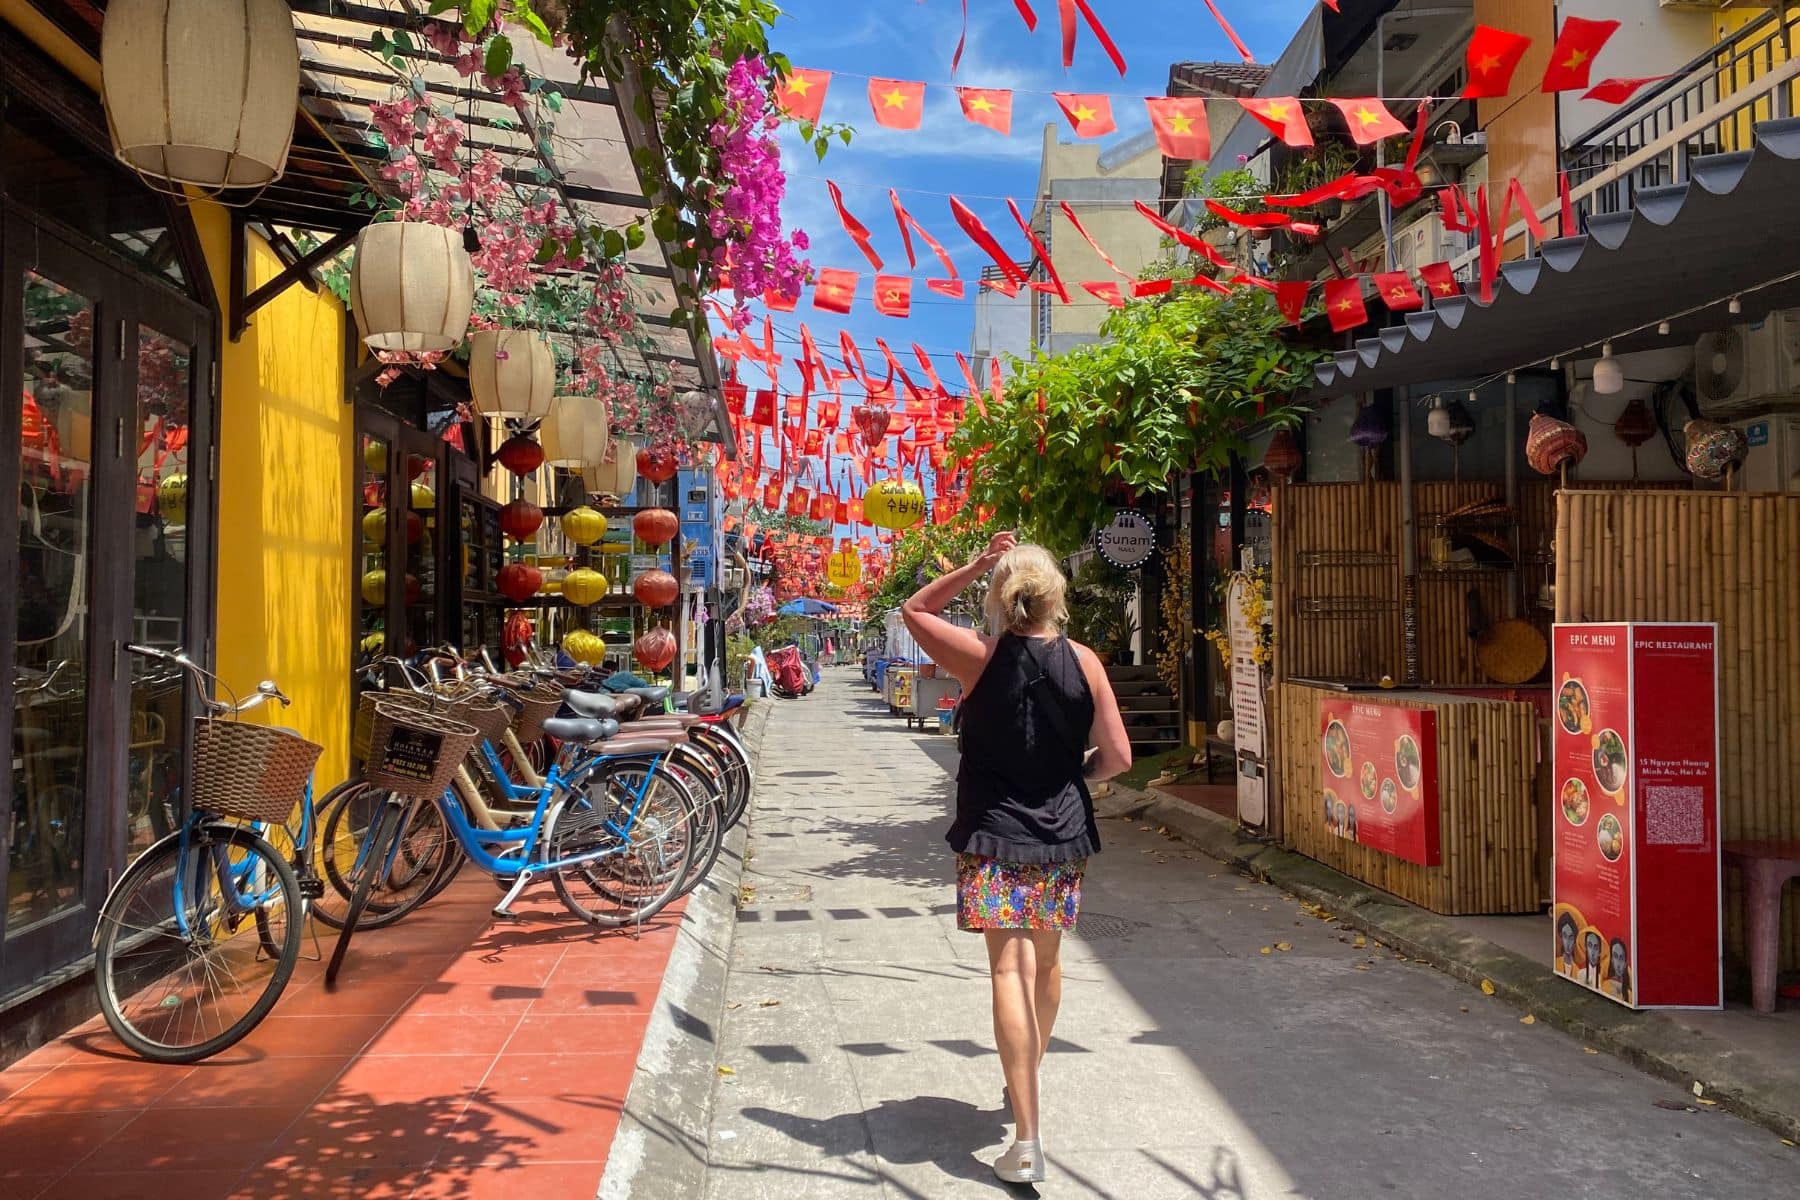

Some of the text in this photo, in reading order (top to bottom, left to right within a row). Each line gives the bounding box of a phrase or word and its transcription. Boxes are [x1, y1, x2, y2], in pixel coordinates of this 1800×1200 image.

[1104, 532, 1149, 545] Sunam
[1570, 635, 1616, 646] EPIC MENU
[1635, 641, 1713, 650] EPIC RESTAURANT
